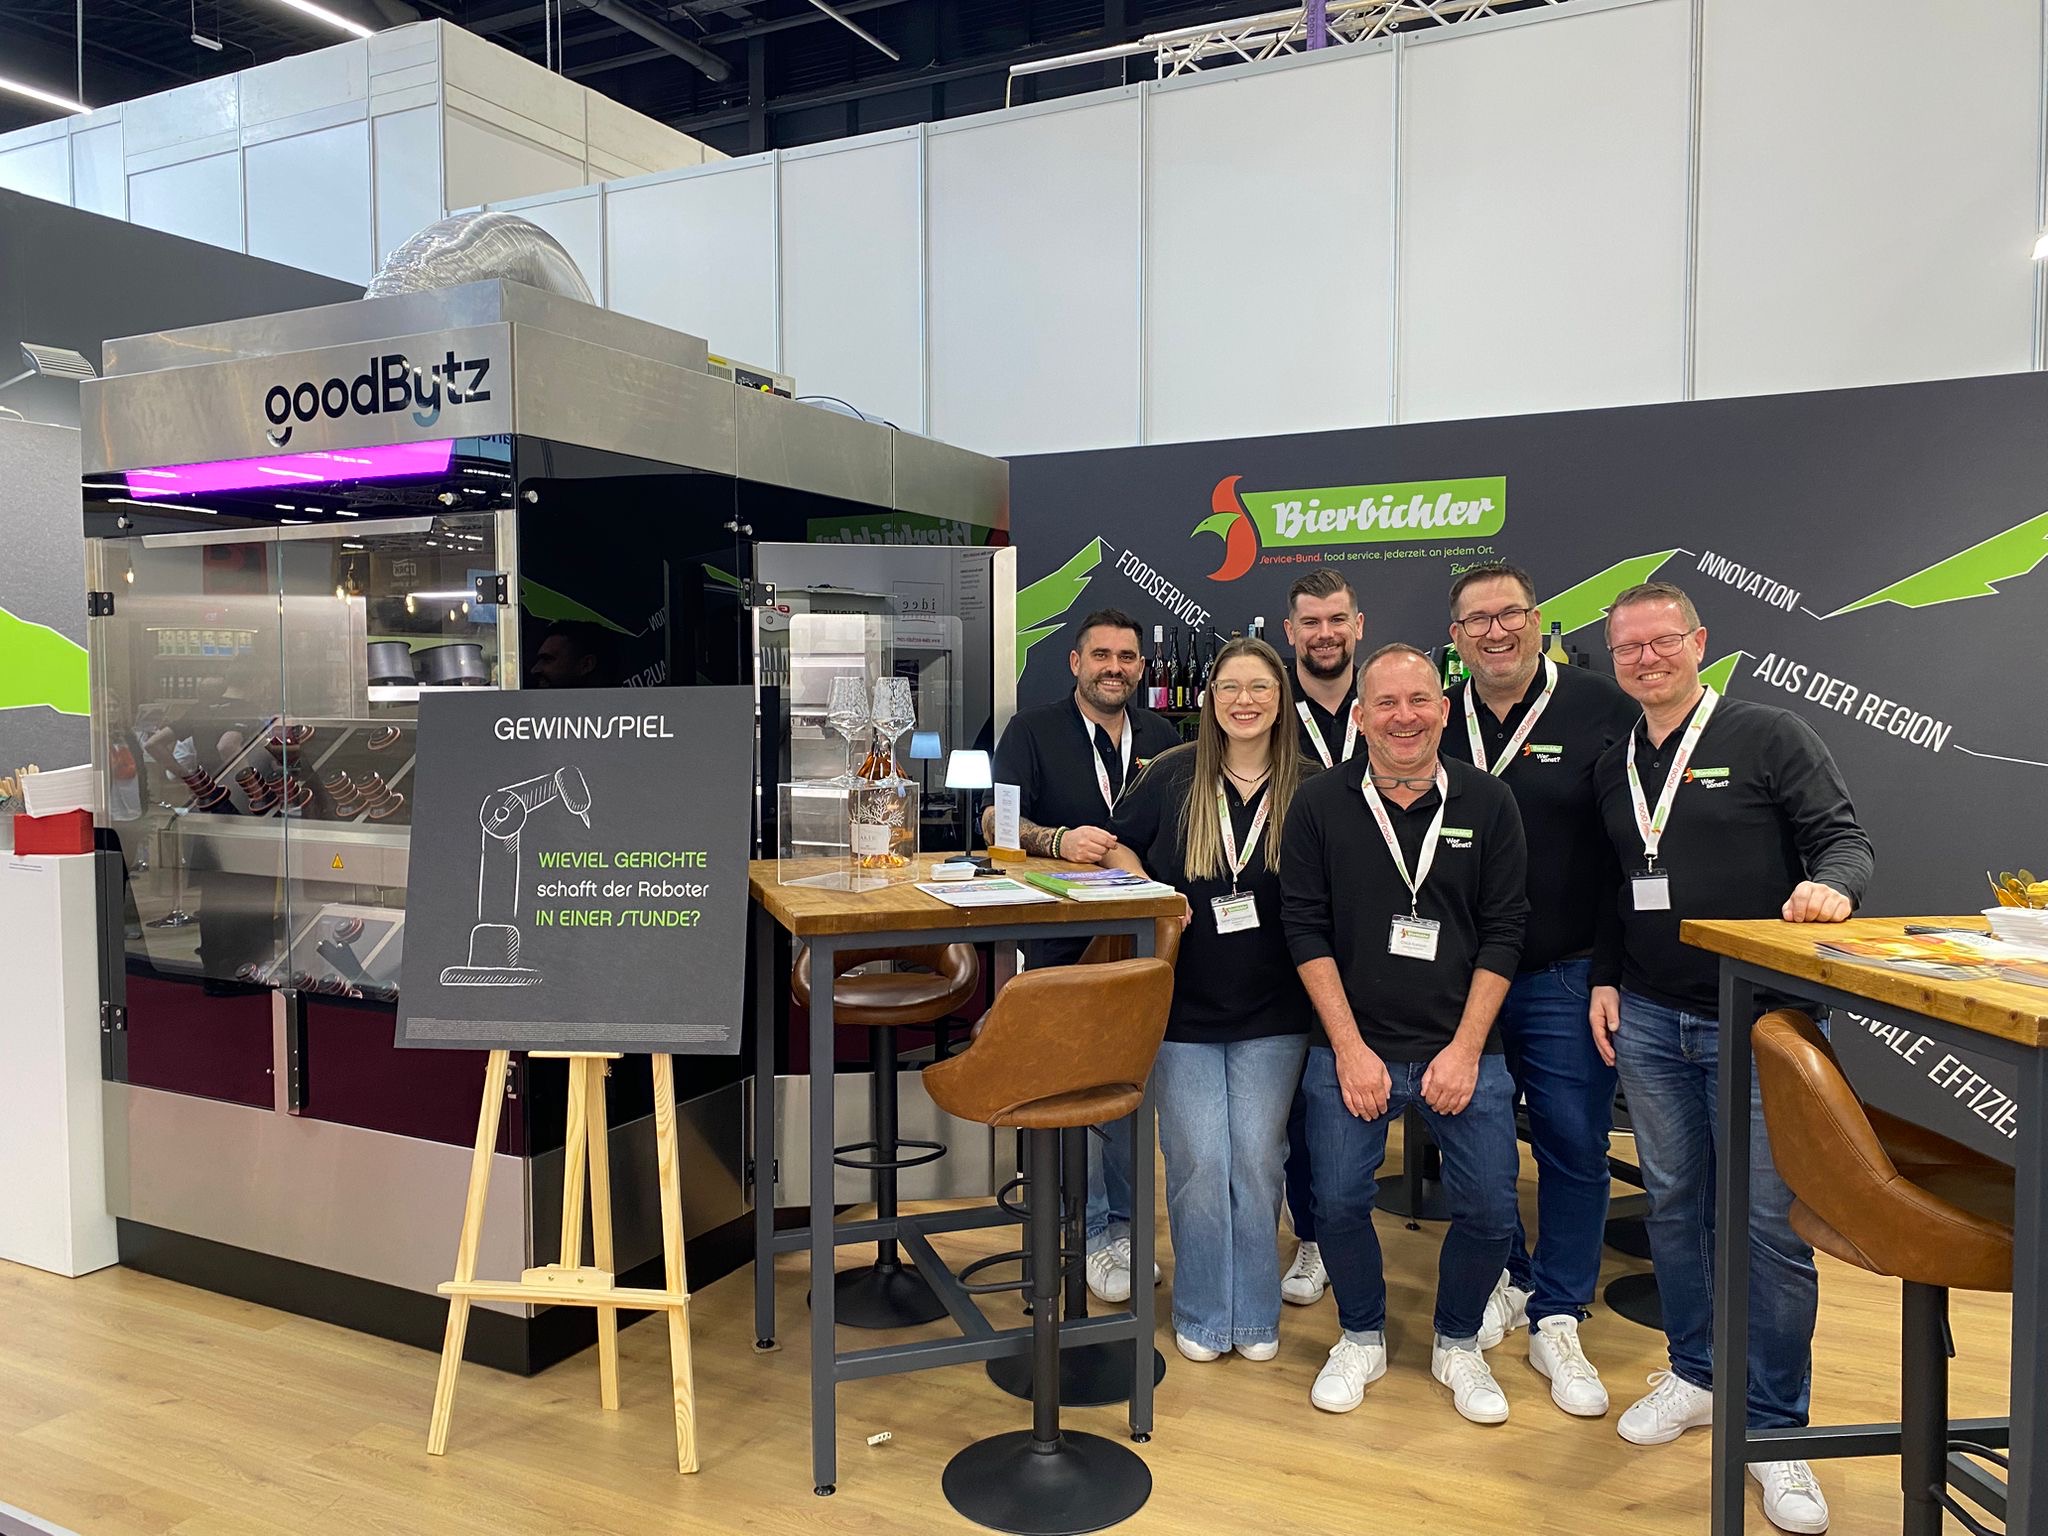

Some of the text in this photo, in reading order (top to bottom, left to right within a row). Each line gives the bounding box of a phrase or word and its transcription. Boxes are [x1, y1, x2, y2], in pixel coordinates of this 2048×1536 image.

[265, 351, 491, 448] goodBytz
[1271, 492, 1495, 539] Bierbichler
[1324, 551, 1345, 562] food
[1429, 548, 1442, 557] an
[1443, 546, 1475, 558] jedem
[1115, 549, 1211, 633] FOODSERVICE
[1696, 550, 1801, 613] INNOVATION
[1752, 653, 1953, 752] AUS DER REGION
[494, 714, 675, 741] GEWINNSPIEL
[538, 851, 708, 869] WIEVIEL GERICHTE
[536, 881, 710, 898] schafft der Roboter
[535, 909, 702, 927] IN EINER STUNDE?
